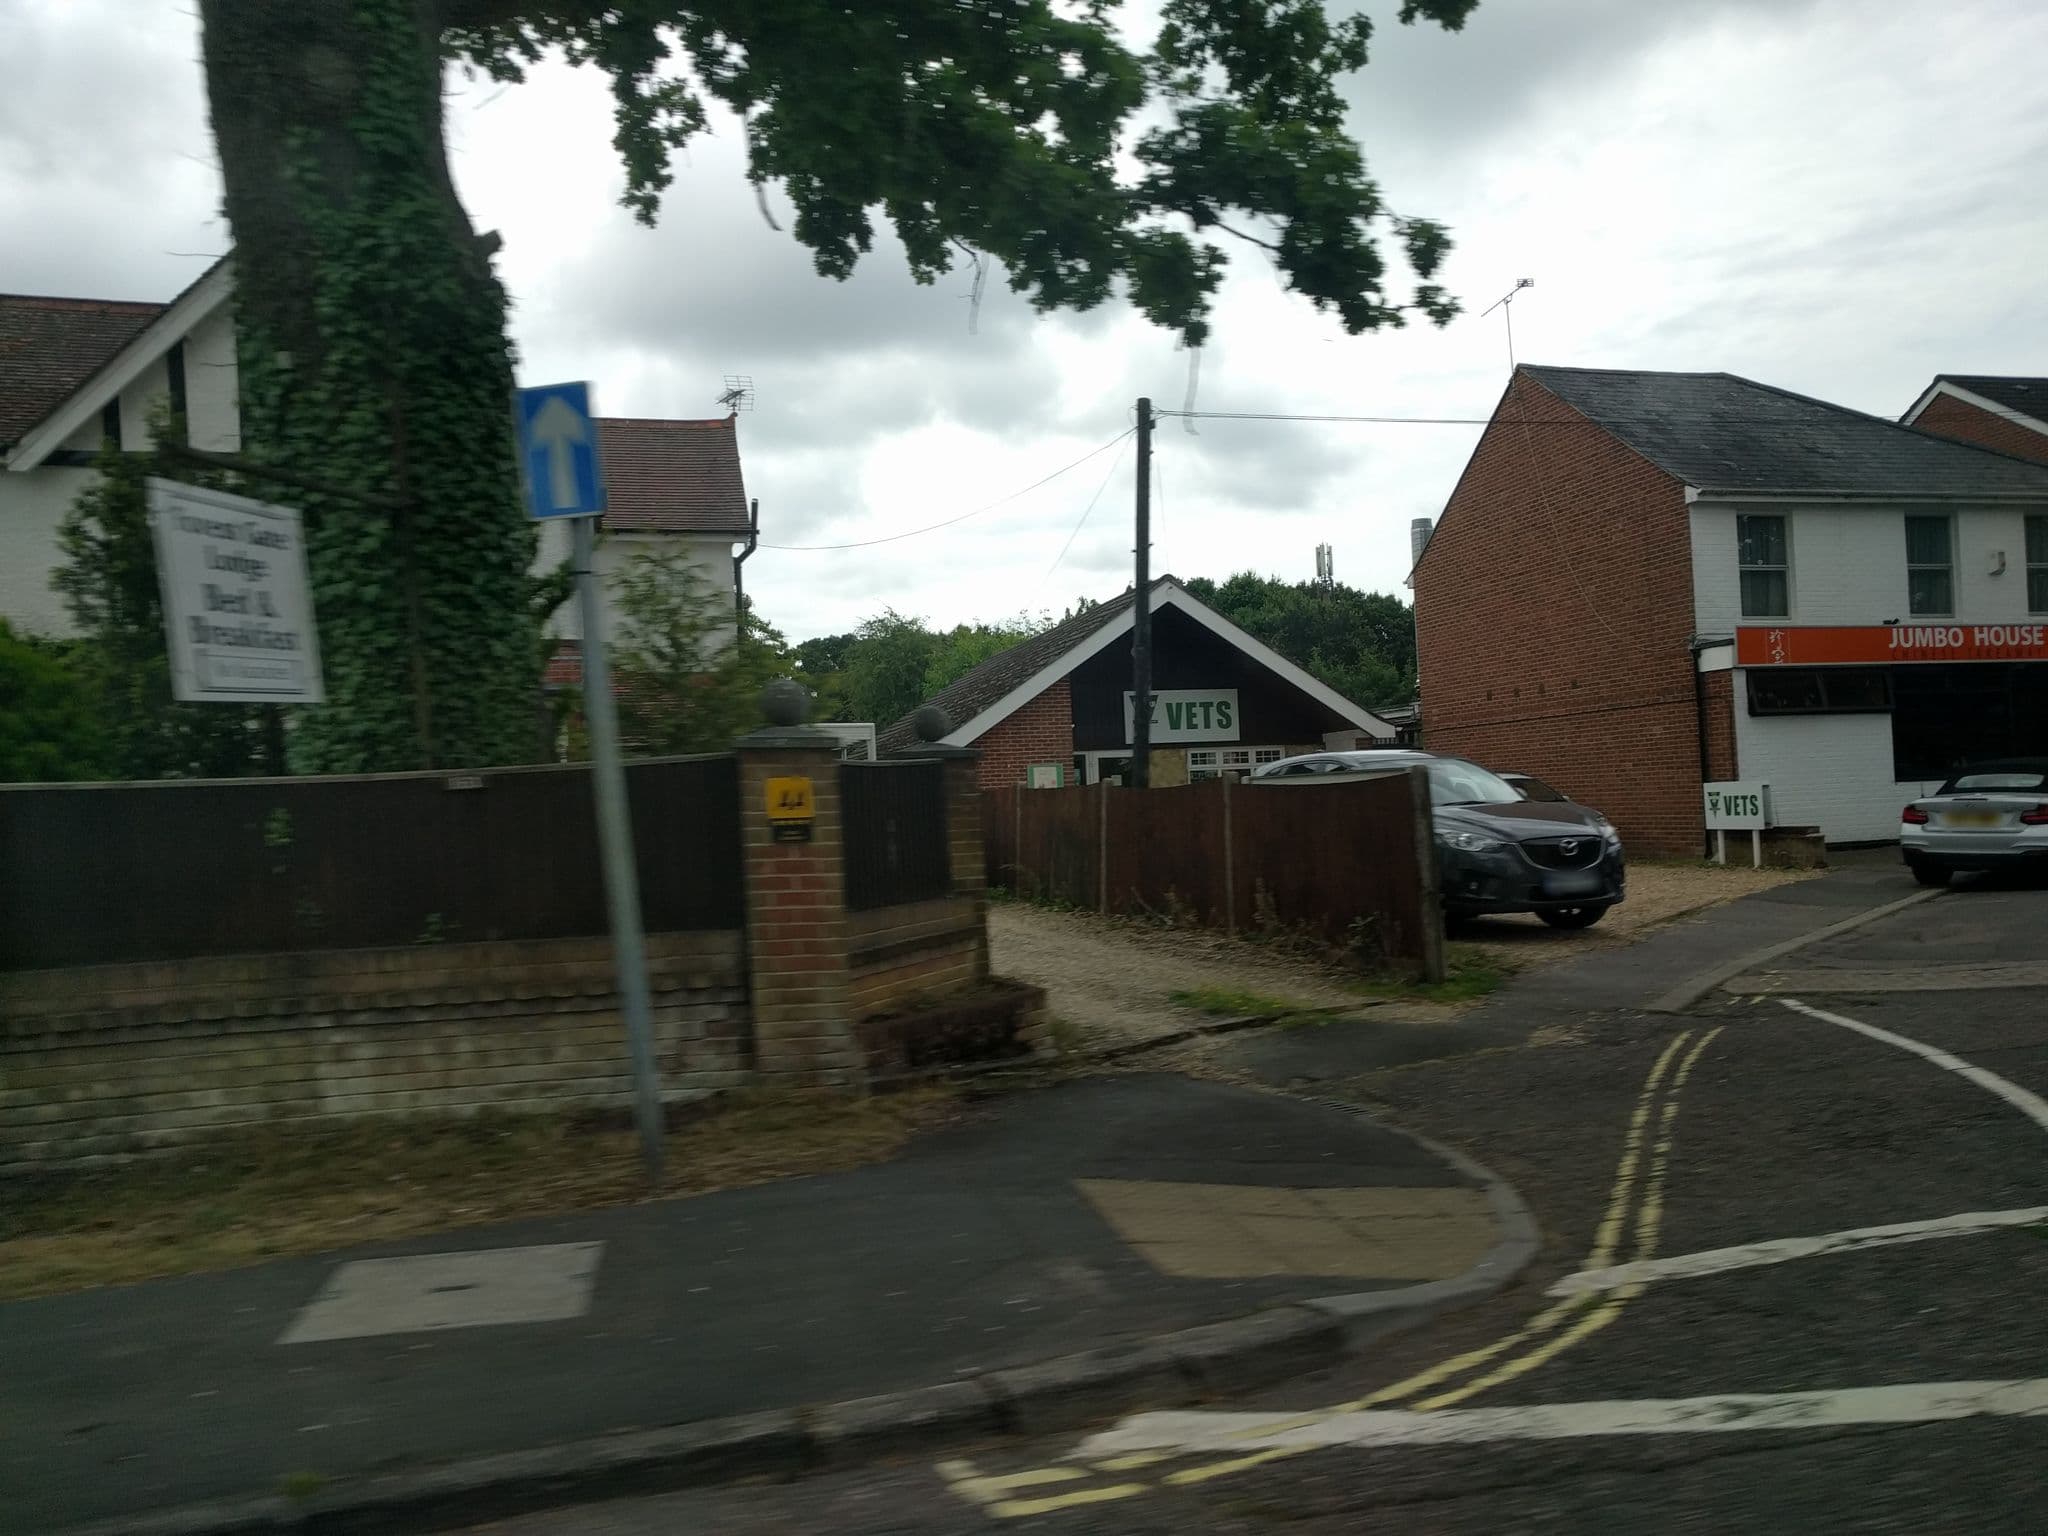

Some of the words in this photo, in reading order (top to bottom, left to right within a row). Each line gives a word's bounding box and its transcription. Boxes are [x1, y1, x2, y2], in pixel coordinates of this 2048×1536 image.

[1888, 627, 1964, 648] JUMBO
[1974, 626, 2045, 646] HOUSE
[1165, 700, 1233, 730] VETS
[1723, 794, 1759, 816] VETS
